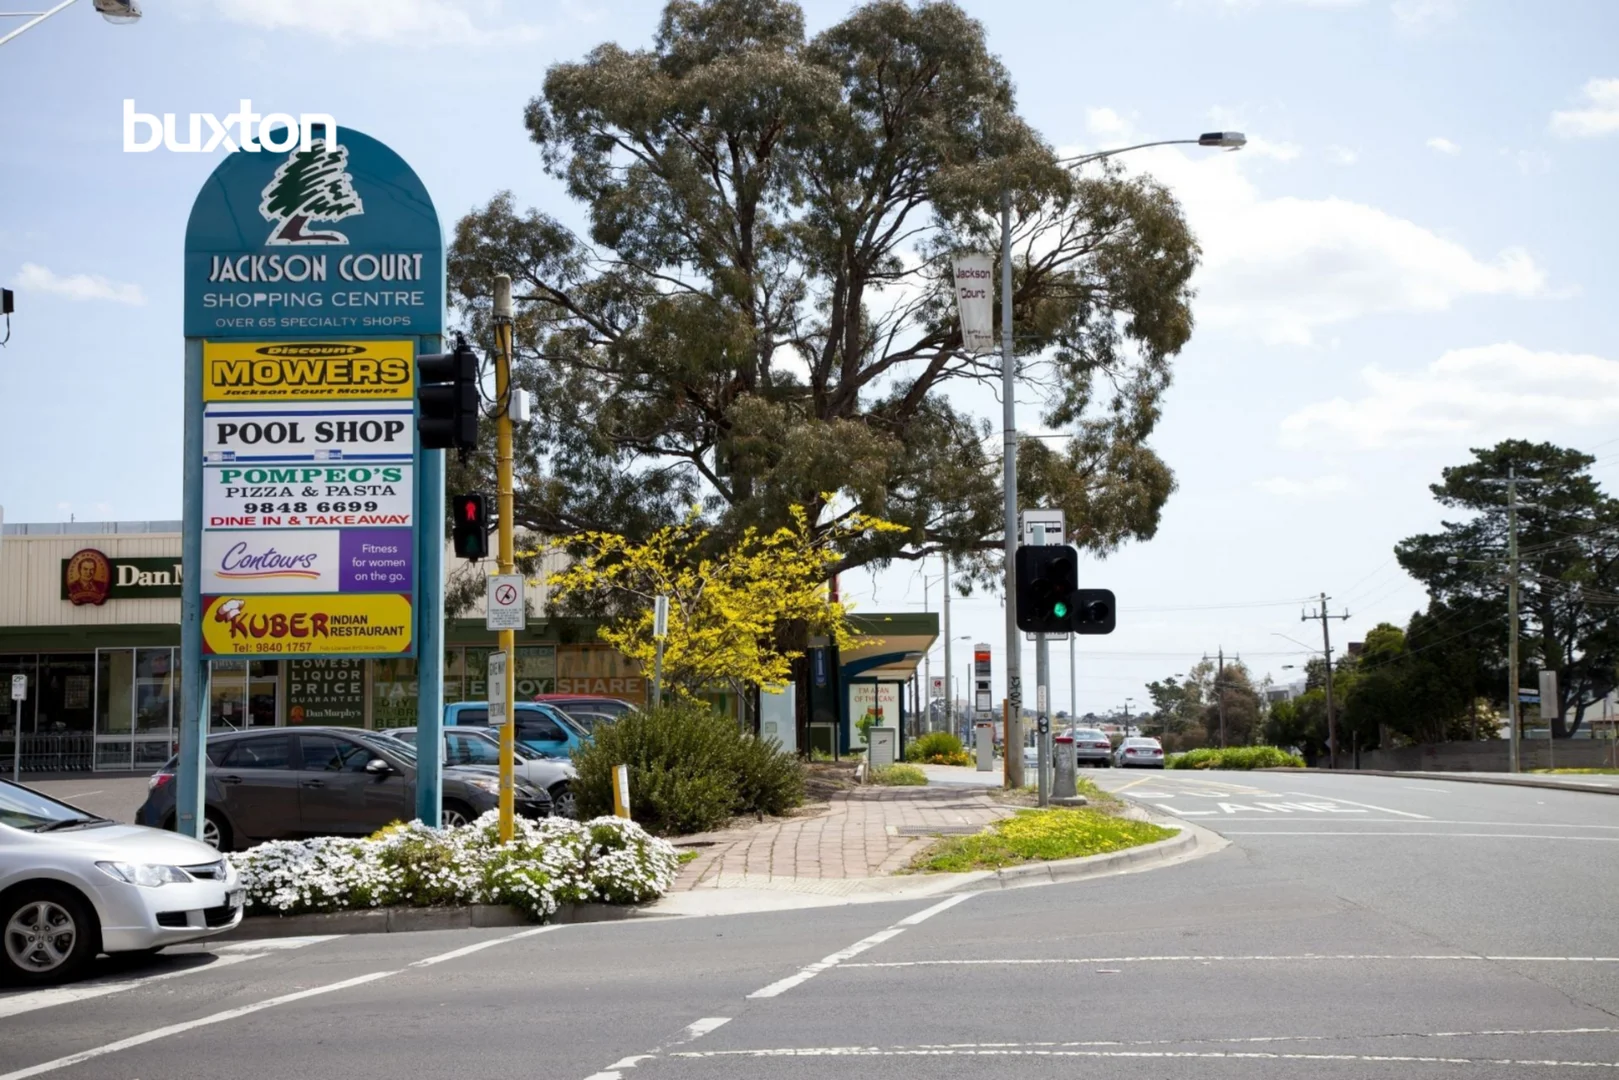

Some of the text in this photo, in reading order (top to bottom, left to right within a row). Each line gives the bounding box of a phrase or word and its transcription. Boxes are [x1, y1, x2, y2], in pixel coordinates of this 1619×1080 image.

[208, 253, 422, 283] JACKSON COURT
[956, 268, 990, 279] Jackson
[203, 291, 424, 307] SHOPPING CENTRE
[961, 287, 986, 299] Court
[216, 316, 411, 328] OVER 65 SPECIALTY SHOPS
[267, 346, 358, 355] Discount
[212, 359, 409, 386] MOWERS
[217, 420, 404, 444] POOL SHOP
[220, 468, 402, 484] POMPEO'S
[225, 485, 396, 498] PIZZA & PASTA
[244, 501, 378, 513] 9848 6699
[210, 517, 256, 526] DINE
[263, 516, 281, 525] IN
[288, 516, 302, 525] &
[362, 544, 397, 553] Fitness
[221, 542, 317, 571] Contours
[352, 557, 405, 567] for women
[116, 565, 171, 586] Dan
[355, 571, 405, 582] on the go.
[229, 612, 329, 639] KUBER
[330, 615, 368, 625] INDIAN
[330, 626, 404, 637] RESTAURANT
[232, 642, 312, 653] Tel: 9840 1757
[291, 659, 360, 668] LOWEST
[291, 671, 360, 681] LIQUOR
[291, 683, 360, 694] PRICE
[557, 679, 640, 694] SHARE
[306, 708, 362, 719] Dan Murphy's
[1156, 802, 1368, 814] LANE
